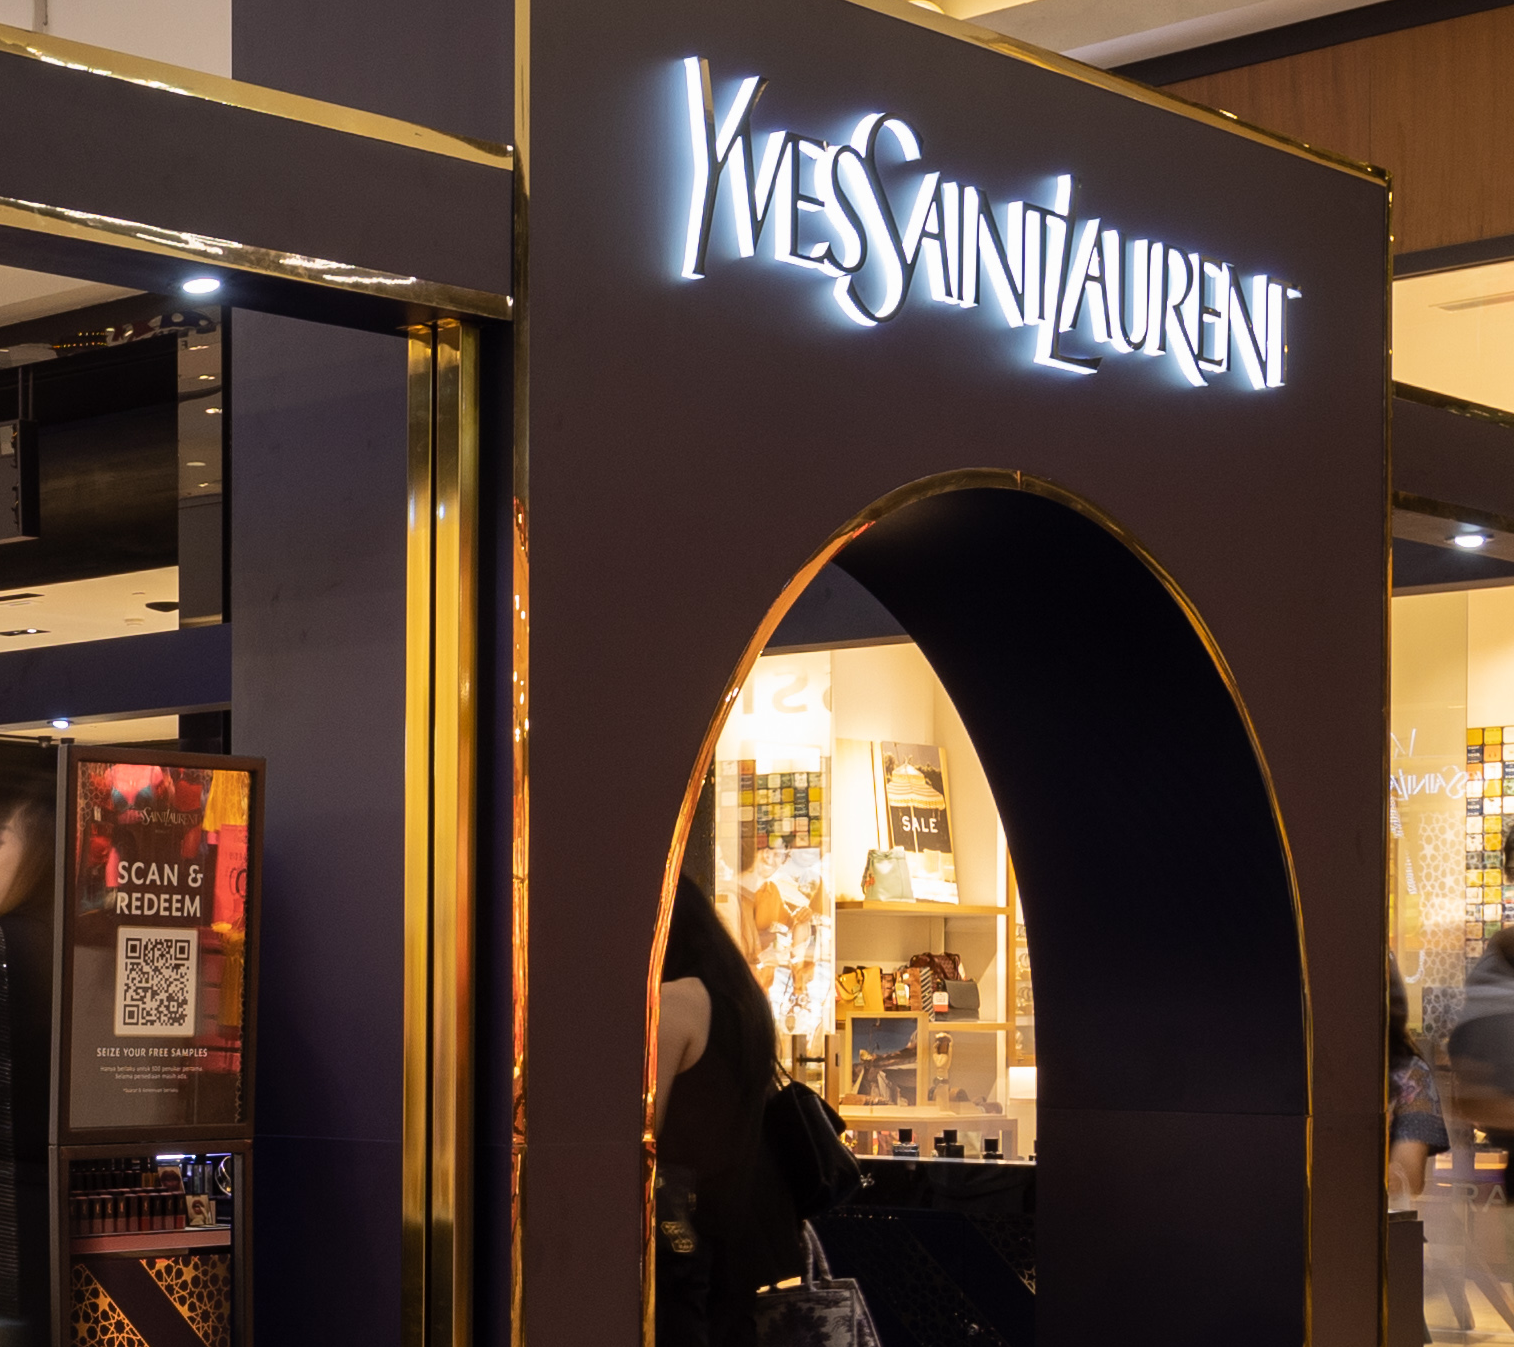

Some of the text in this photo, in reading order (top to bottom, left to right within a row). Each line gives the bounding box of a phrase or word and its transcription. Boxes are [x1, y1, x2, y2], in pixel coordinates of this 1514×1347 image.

[901, 815, 938, 834] SALE
[117, 860, 178, 887] SCAN
[188, 864, 203, 888] &
[116, 891, 201, 918] REDEEM
[96, 1047, 208, 1058] SEIZE YOUR FREE SAMPLES
